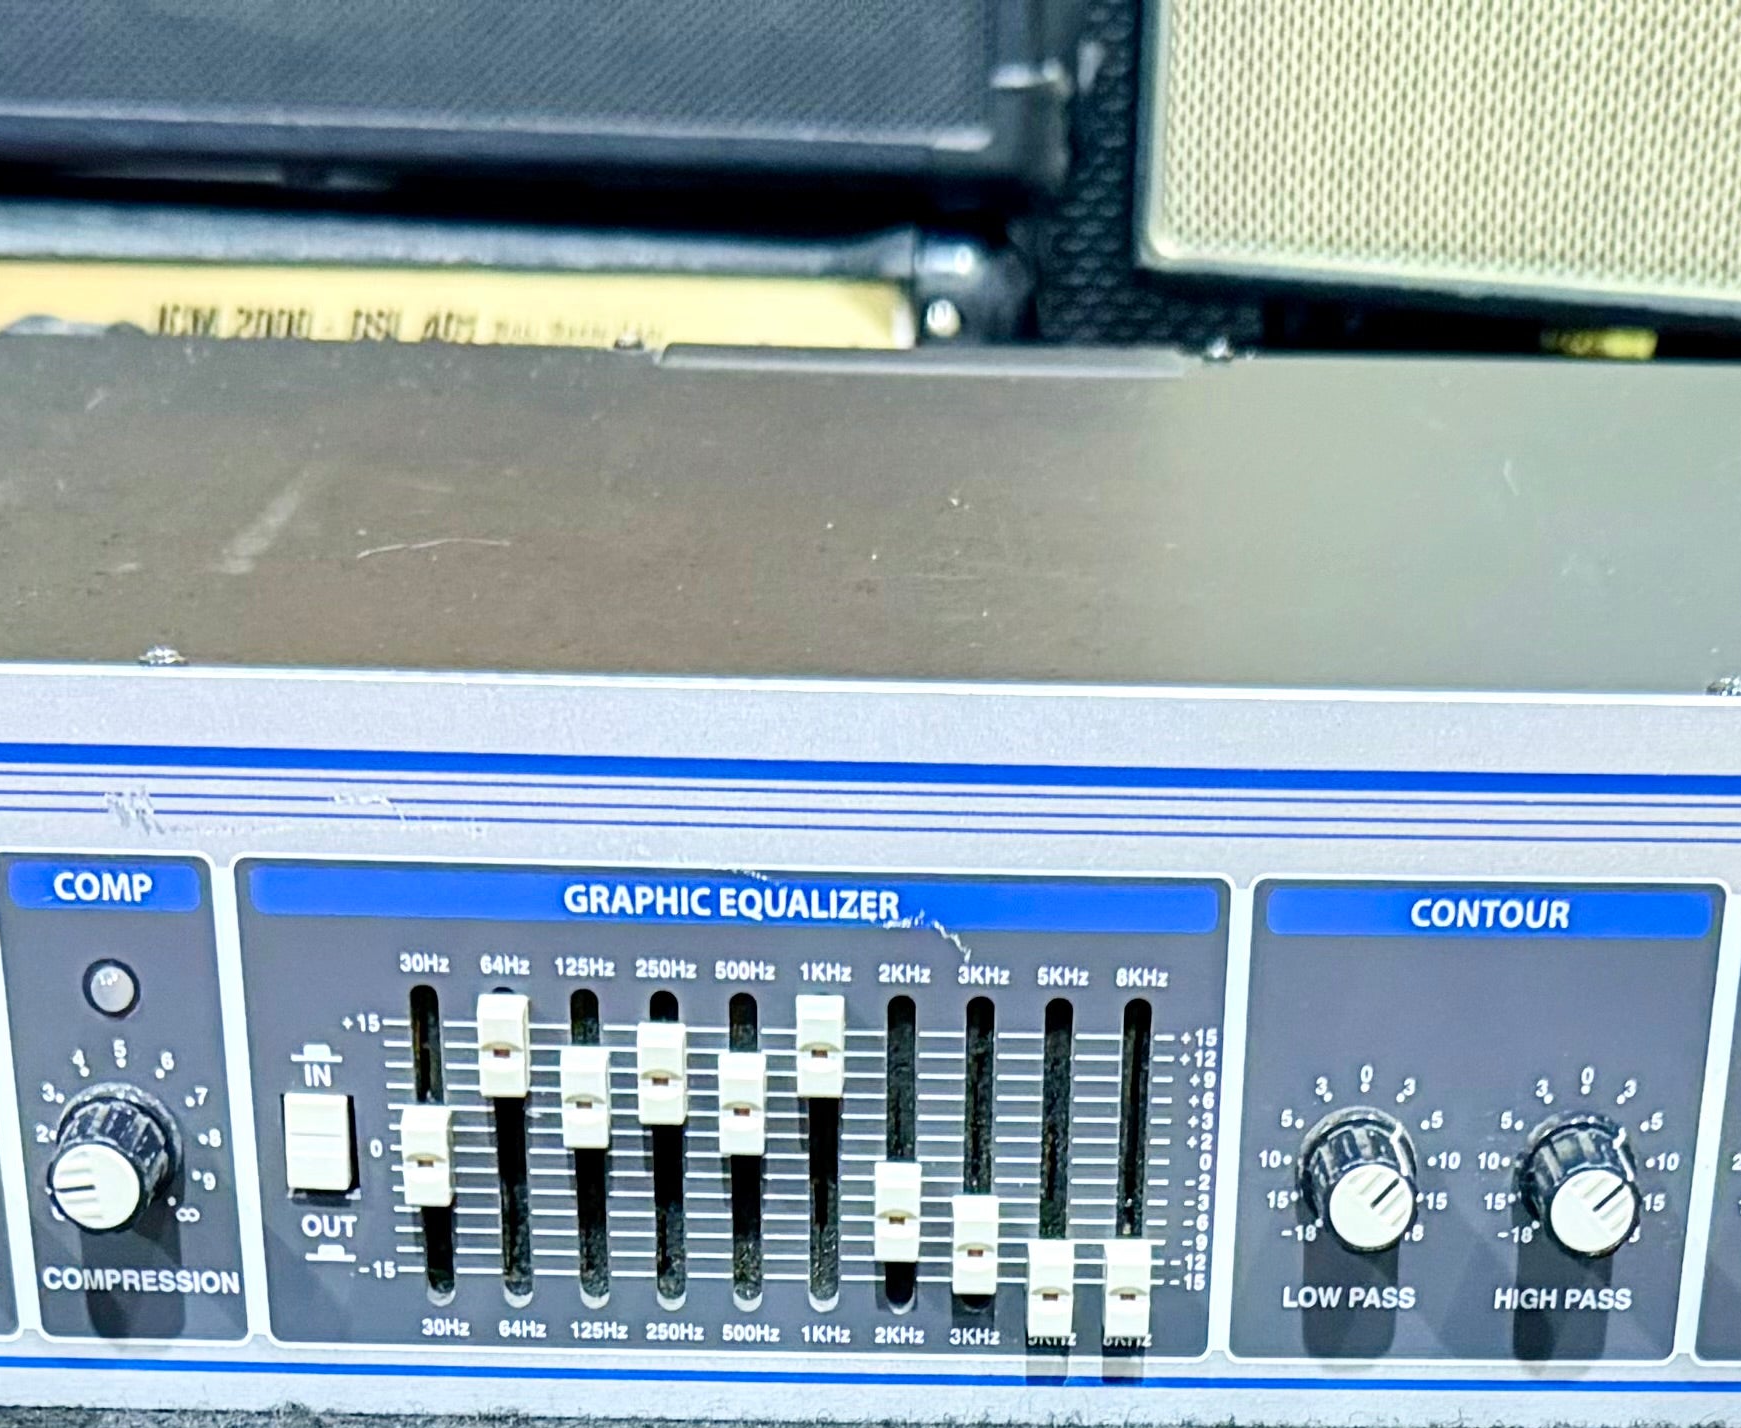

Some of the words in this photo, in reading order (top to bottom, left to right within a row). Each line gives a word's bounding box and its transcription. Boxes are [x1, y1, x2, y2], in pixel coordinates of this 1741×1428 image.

[53, 873, 152, 902] COMP
[564, 884, 712, 916] GRAPHIC
[720, 887, 899, 921] EQUALIZER
[1410, 898, 1570, 930] CONTOUR
[400, 954, 450, 973] 30Hz
[480, 955, 530, 975] 64Hz
[555, 957, 615, 978] 125Hz
[635, 959, 696, 980] 250Hz
[715, 961, 775, 981] 500Hz
[800, 963, 852, 982] 1KHz
[878, 964, 931, 984] 2KHz
[958, 965, 1010, 986] 3KHz
[1037, 966, 1089, 986] 5KHz
[342, 1014, 380, 1032] +15
[114, 1040, 126, 1057] 5
[71, 1050, 84, 1067] 4
[161, 1052, 174, 1070] 6
[305, 1065, 332, 1086] IN
[1361, 1065, 1373, 1082] 0
[1582, 1067, 1595, 1084] 0
[42, 1084, 55, 1101] 3
[1316, 1077, 1327, 1095] 3
[1404, 1078, 1416, 1096] 3
[1537, 1080, 1548, 1098] 3
[1625, 1080, 1637, 1098] 3
[195, 1087, 208, 1105] 7
[1281, 1109, 1294, 1128] 5
[1430, 1111, 1443, 1129] 5
[1501, 1111, 1513, 1130] 5
[1651, 1112, 1663, 1130] 5
[36, 1126, 49, 1143] 2
[208, 1130, 221, 1147] 8
[369, 1141, 382, 1157] 0
[1259, 1151, 1281, 1168] 10
[1437, 1151, 1461, 1169] 10
[1478, 1152, 1500, 1169] 10
[1657, 1153, 1679, 1170] 10
[203, 1173, 216, 1190] 9
[1266, 1192, 1289, 1209] 15
[1425, 1192, 1447, 1210] 15
[1484, 1193, 1507, 1210] 15
[1643, 1194, 1665, 1211] 15
[301, 1215, 357, 1237] OUT
[358, 1262, 396, 1279] -15
[42, 1267, 240, 1294] COMPRESSION
[1283, 1286, 1343, 1308] LOW
[1348, 1287, 1415, 1309] PASS
[1494, 1288, 1556, 1310] HIGH
[1565, 1289, 1632, 1310] PASS
[422, 1318, 470, 1337] 30Hz
[498, 1319, 546, 1338] 64Hz
[571, 1321, 628, 1340] 125Hz
[646, 1322, 704, 1341] 250Hz
[723, 1324, 780, 1342] 500Hz
[801, 1325, 851, 1344] 1KHz
[875, 1326, 924, 1344] 2KHz
[950, 1327, 1000, 1346] 3KHz
